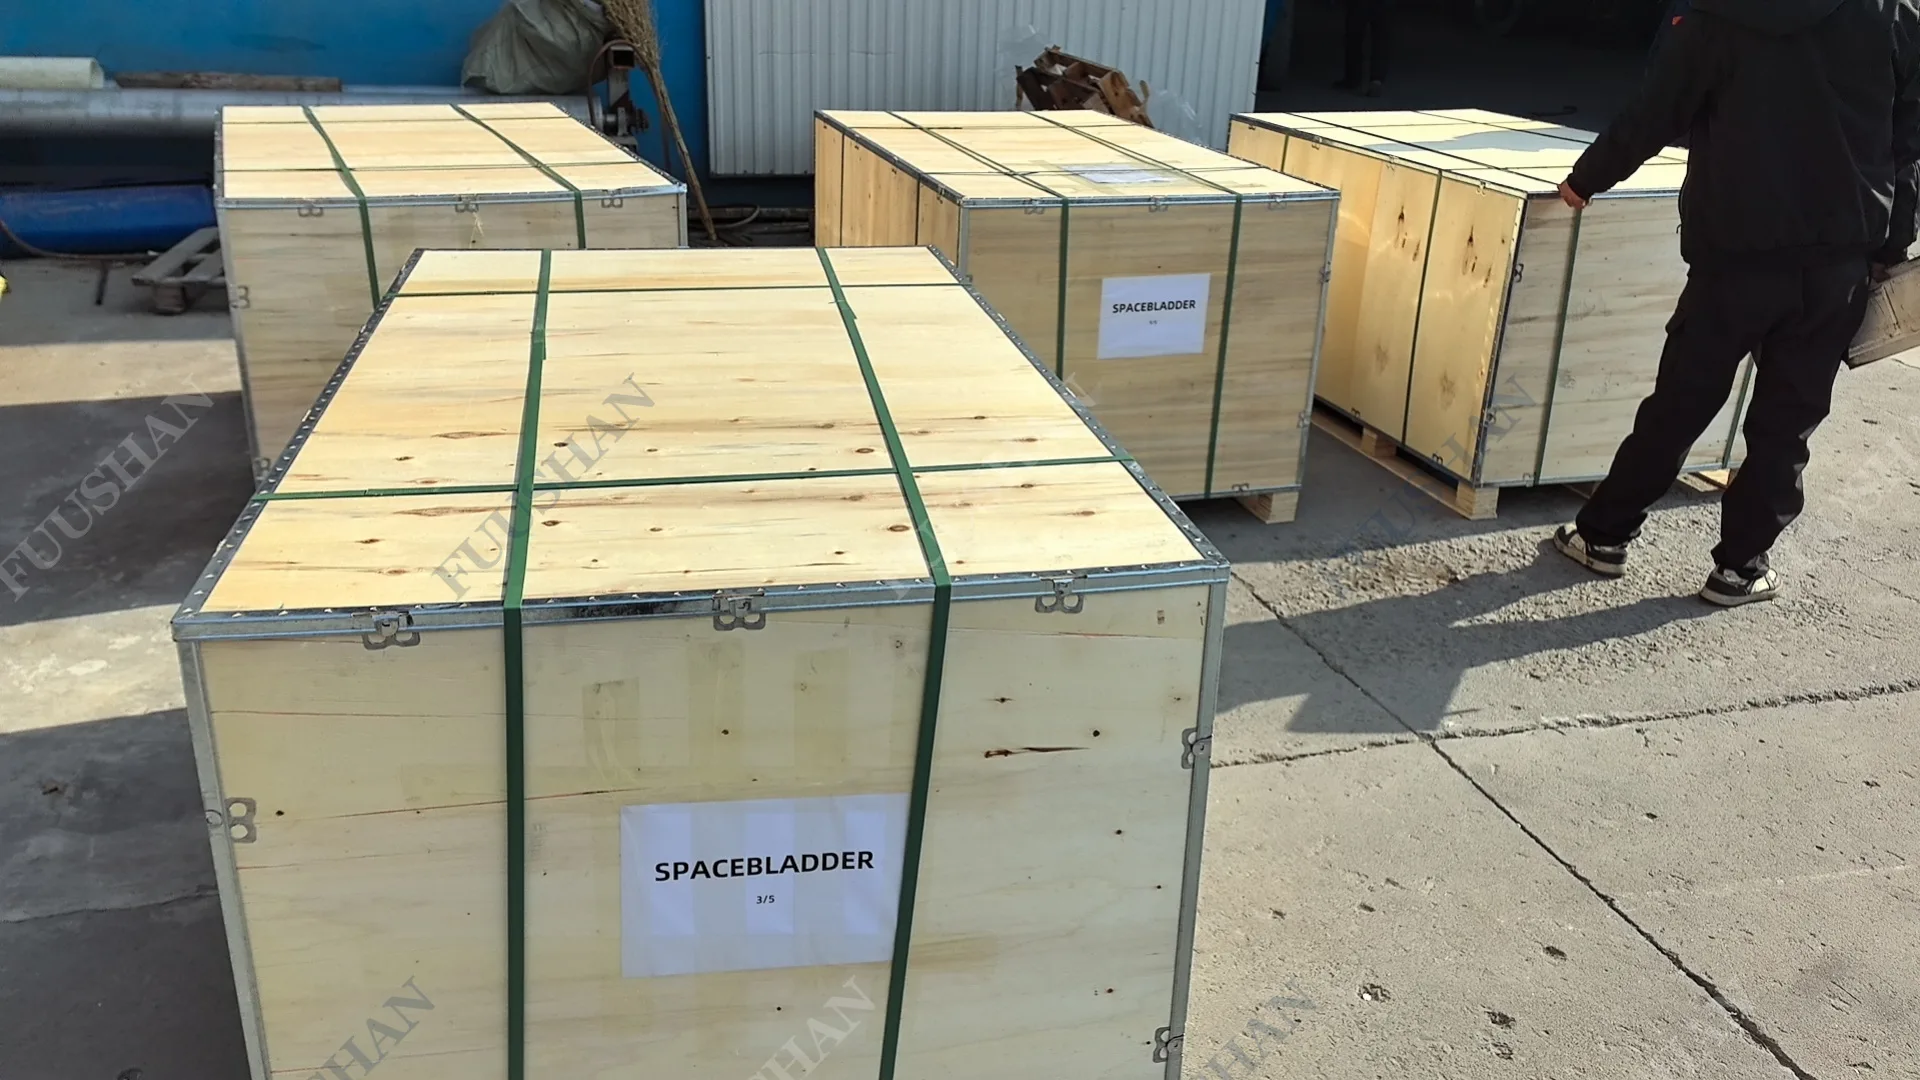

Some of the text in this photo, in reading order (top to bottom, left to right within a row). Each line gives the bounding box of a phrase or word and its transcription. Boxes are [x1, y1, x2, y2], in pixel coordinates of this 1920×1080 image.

[1112, 299, 1196, 314] SPACEBLADDER
[655, 850, 874, 881] SPACEBLADDER
[755, 894, 776, 905] 3/5
